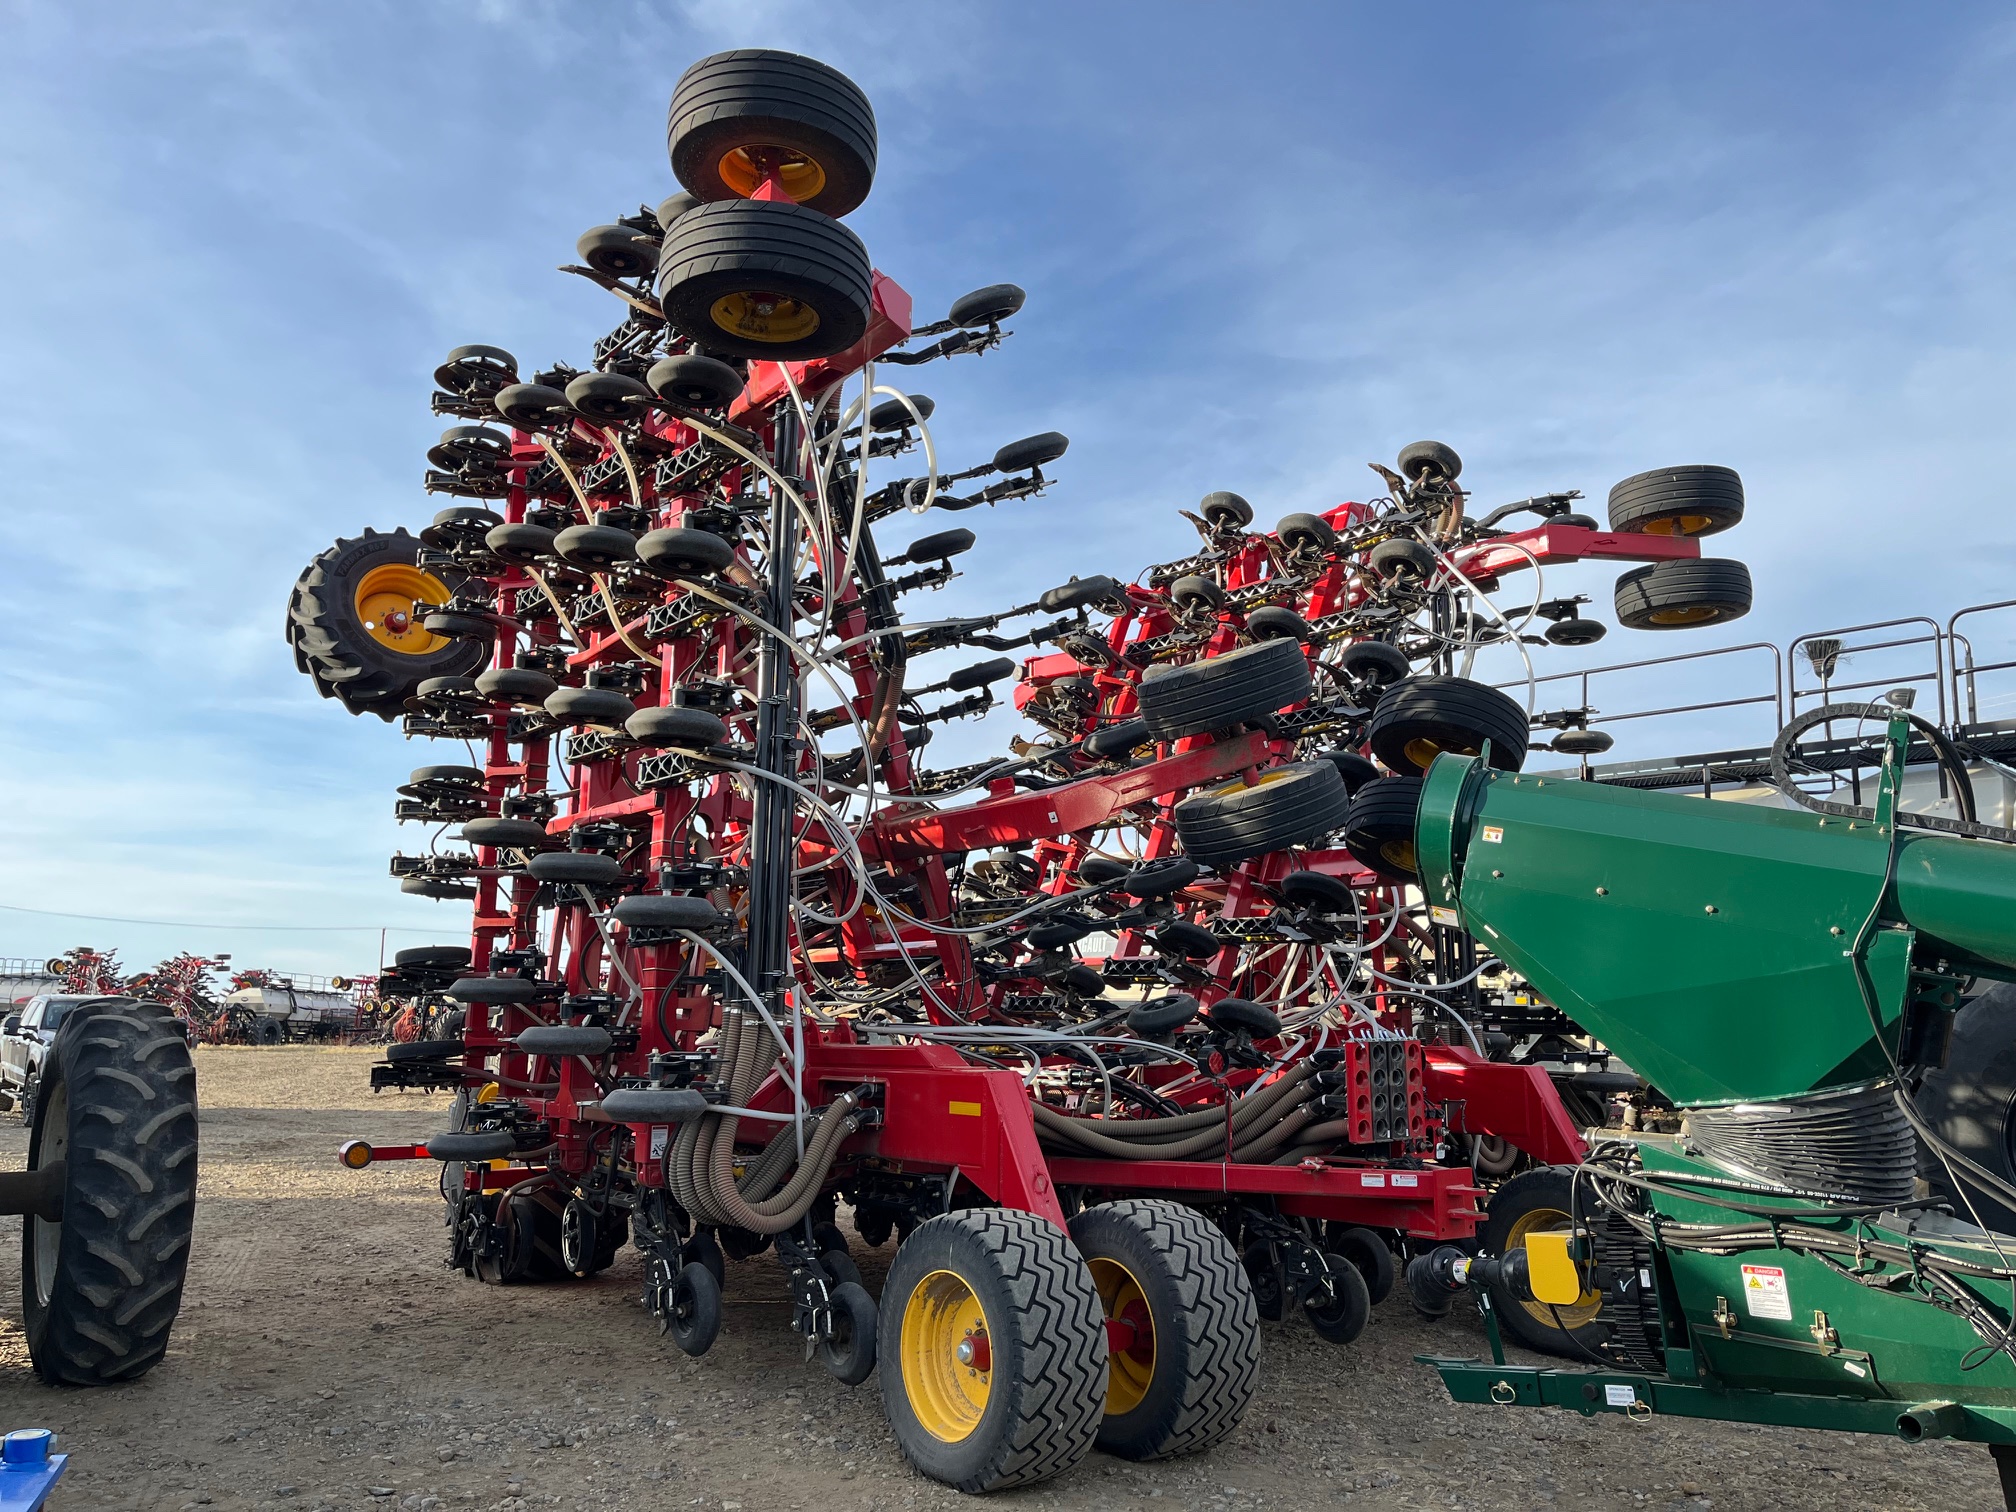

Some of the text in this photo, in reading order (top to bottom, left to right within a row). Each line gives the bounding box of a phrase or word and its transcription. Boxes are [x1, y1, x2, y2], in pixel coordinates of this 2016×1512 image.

[337, 541, 386, 575] FARMAX R65
[1754, 1268, 1779, 1276] DANGER
